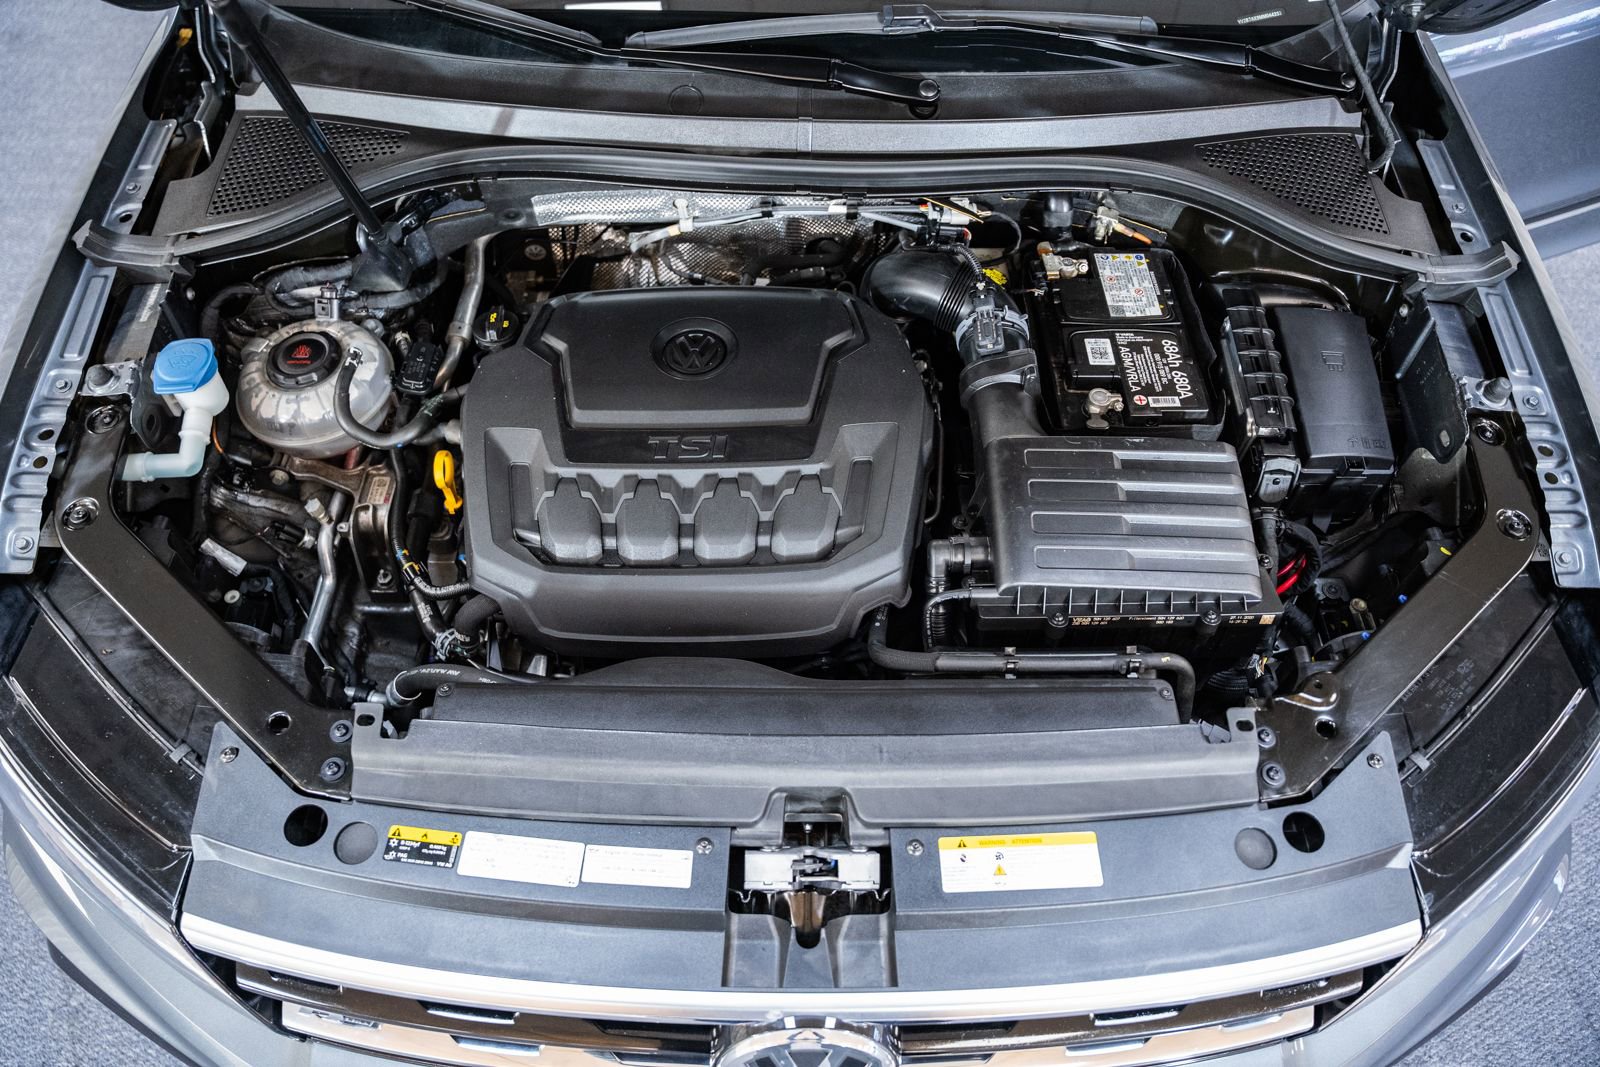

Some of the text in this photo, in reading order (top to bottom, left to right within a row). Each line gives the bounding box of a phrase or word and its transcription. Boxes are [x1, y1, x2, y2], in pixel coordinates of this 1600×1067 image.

[1118, 346, 1142, 392] AGM/VRLA
[1161, 339, 1194, 399] 68Ah 680A
[648, 434, 728, 459] TSI
